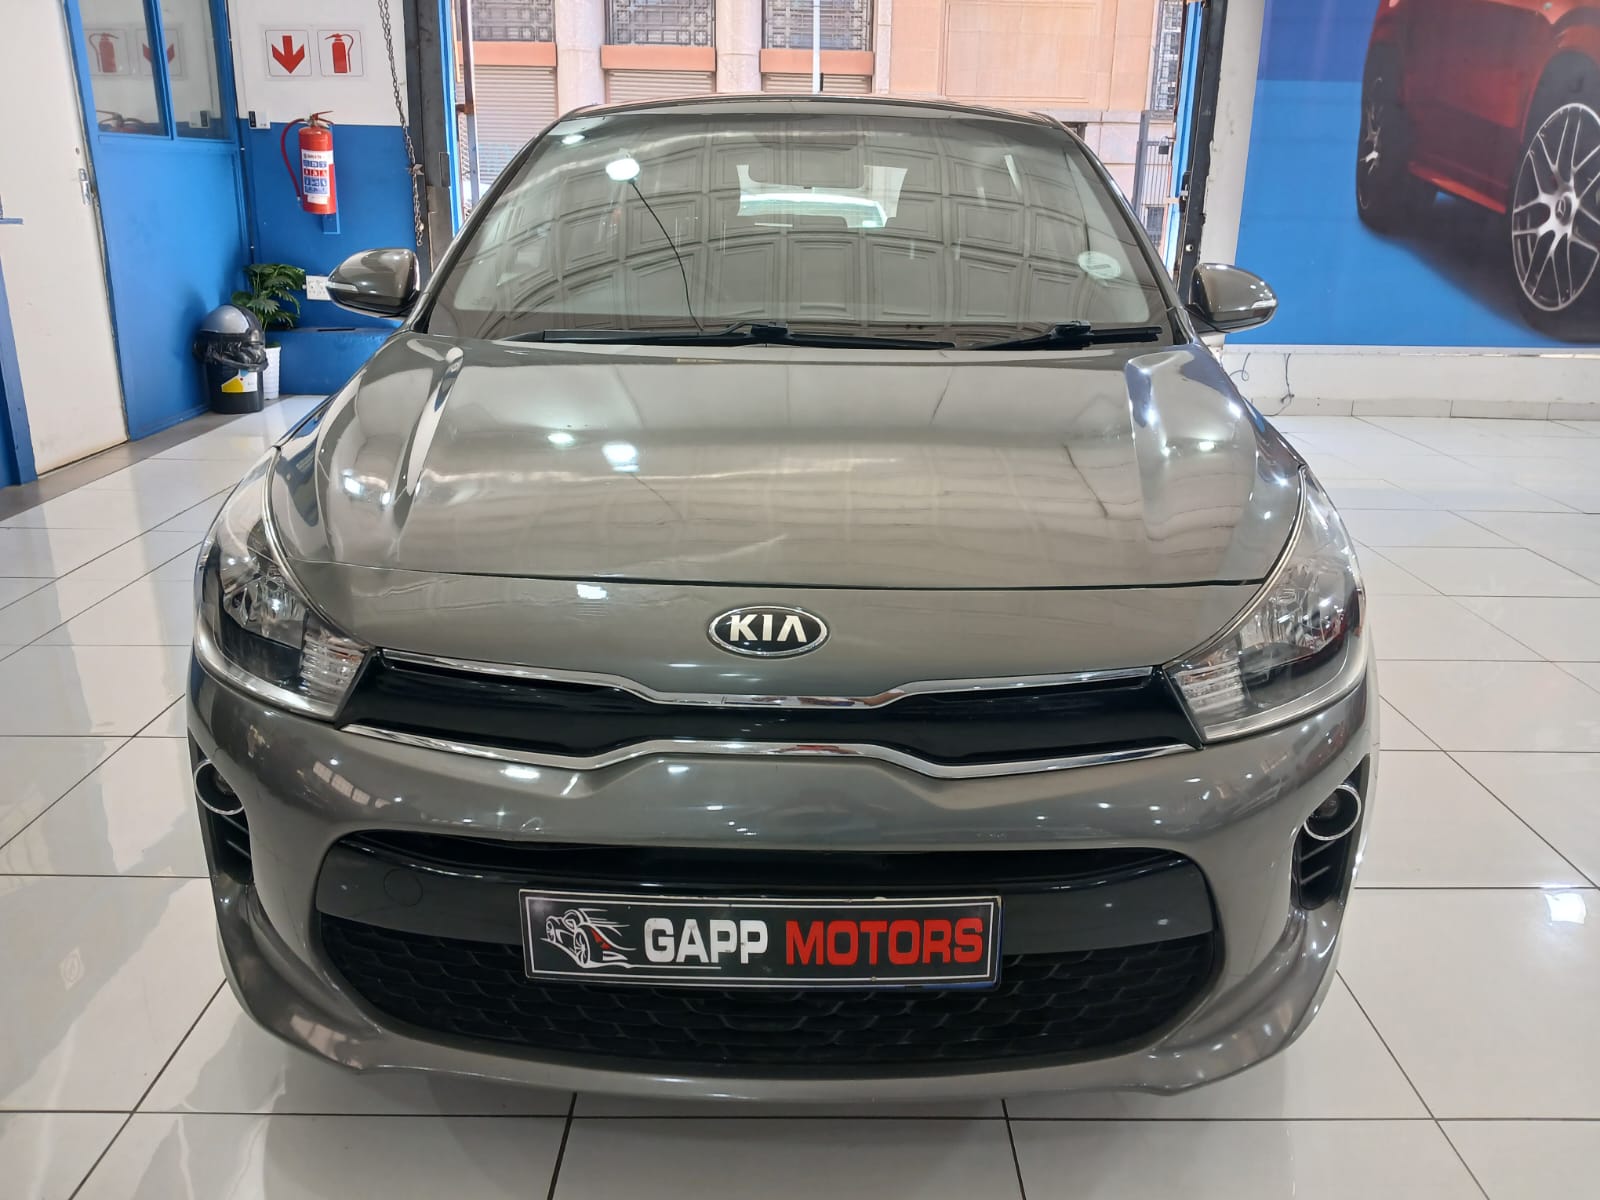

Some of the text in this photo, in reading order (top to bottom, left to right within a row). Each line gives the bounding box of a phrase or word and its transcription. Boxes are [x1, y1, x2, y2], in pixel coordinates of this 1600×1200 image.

[729, 613, 807, 643] KIA
[643, 917, 984, 966] GAPP MOTORS
